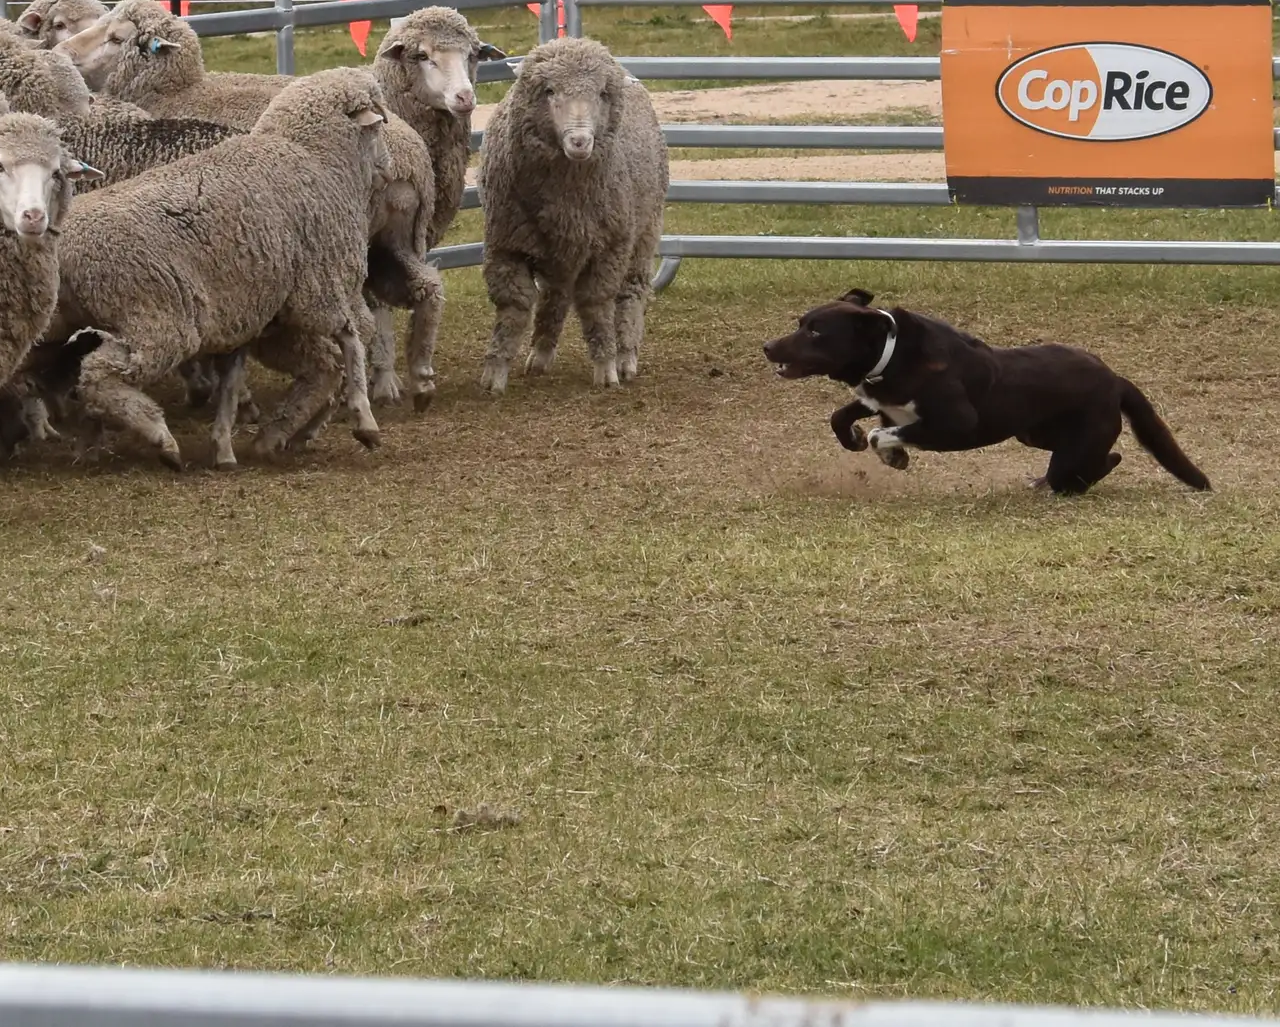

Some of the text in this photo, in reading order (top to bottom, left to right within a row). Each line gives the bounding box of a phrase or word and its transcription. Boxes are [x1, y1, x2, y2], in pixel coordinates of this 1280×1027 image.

[1017, 69, 1190, 121] CopRice
[1048, 186, 1164, 195] NUTRITION THAT STACKS UP
